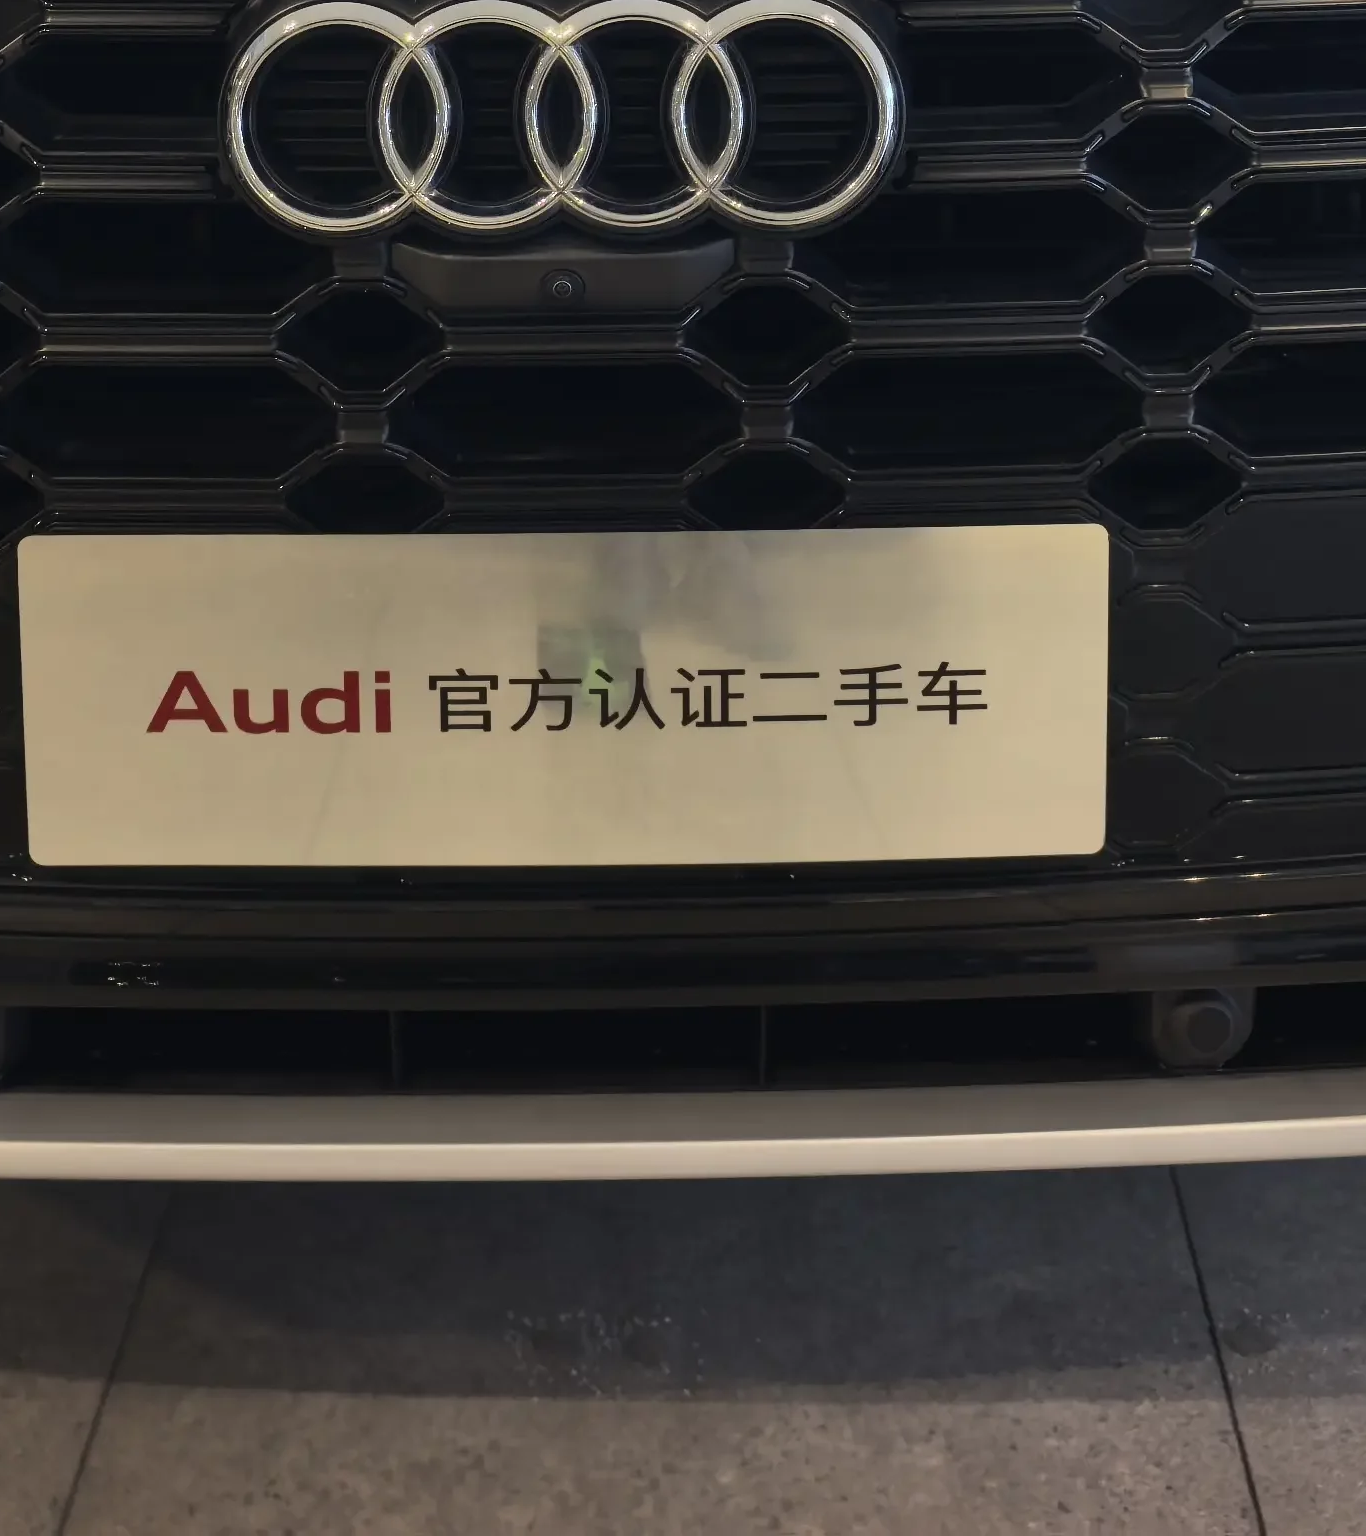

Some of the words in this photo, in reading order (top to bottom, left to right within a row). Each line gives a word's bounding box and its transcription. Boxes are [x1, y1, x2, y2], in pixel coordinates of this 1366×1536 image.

[146, 670, 392, 734] Audi
[428, 661, 989, 733] 官方认证二手车
